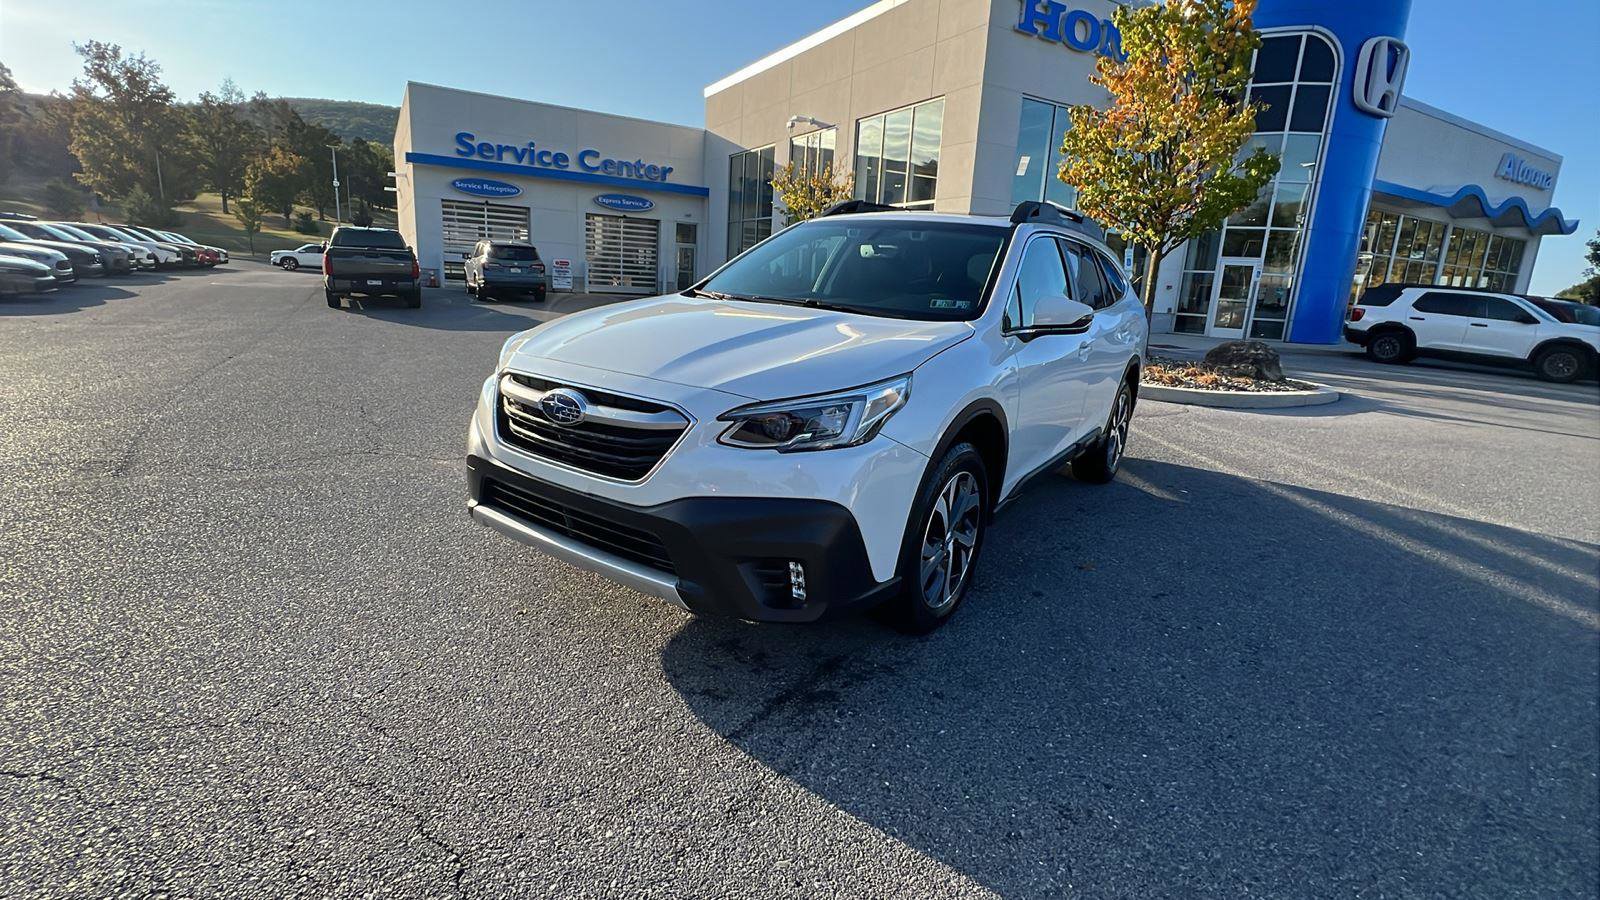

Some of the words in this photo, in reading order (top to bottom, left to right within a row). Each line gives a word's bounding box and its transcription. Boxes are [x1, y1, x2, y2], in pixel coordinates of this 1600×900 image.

[1015, 0, 1130, 63] HON
[455, 132, 569, 168] Service
[577, 150, 673, 181] Center
[1496, 152, 1554, 190] Altoona
[455, 181, 482, 191] Service
[483, 184, 518, 195] Reception
[598, 197, 620, 206] Express
[621, 198, 644, 208] Service
